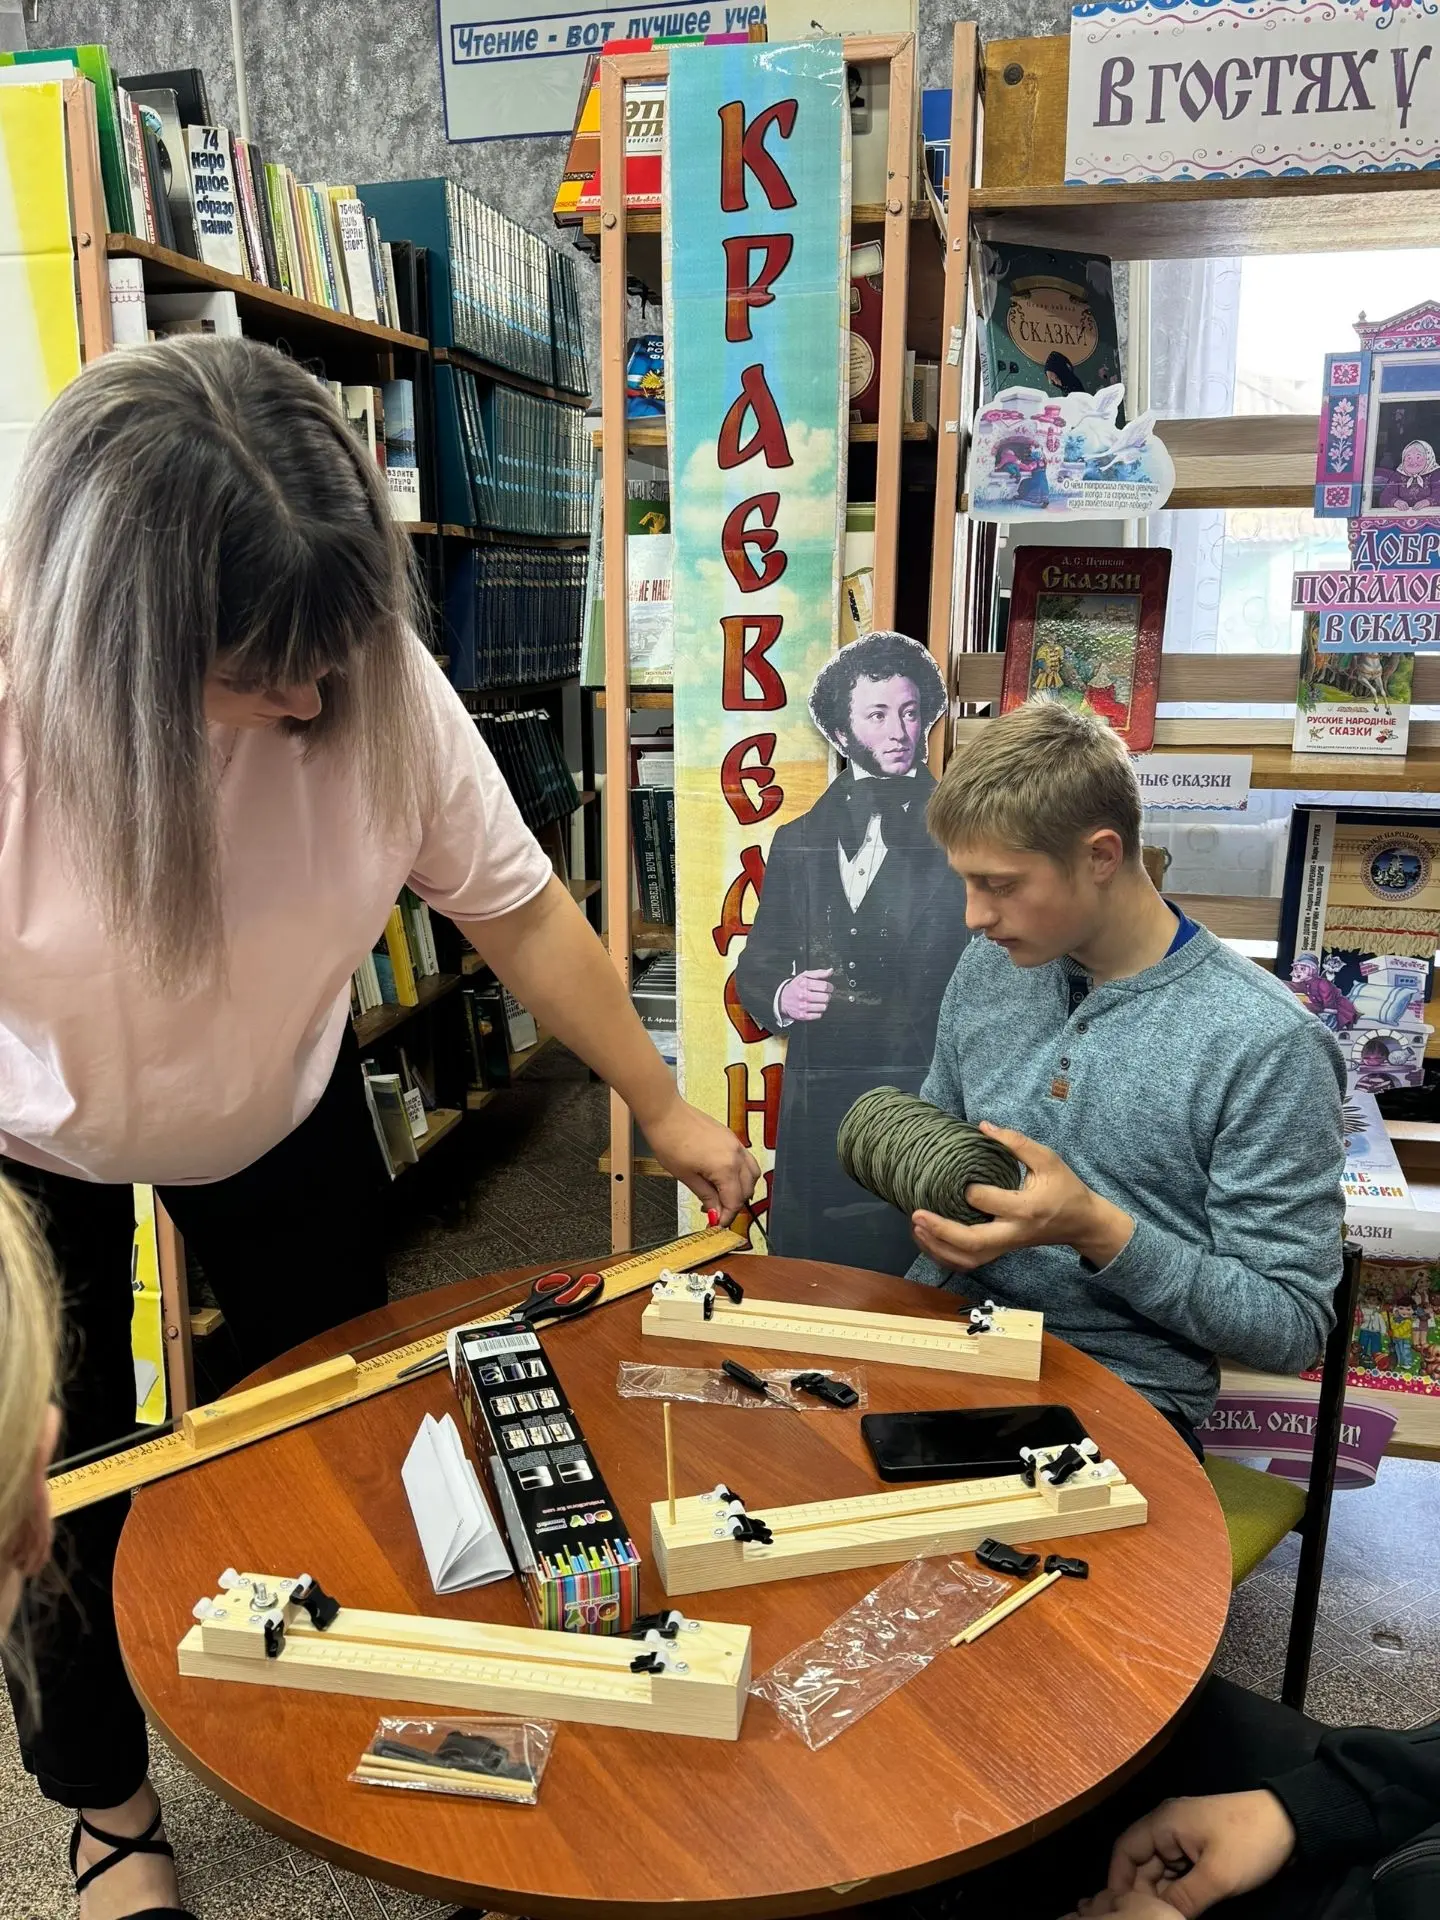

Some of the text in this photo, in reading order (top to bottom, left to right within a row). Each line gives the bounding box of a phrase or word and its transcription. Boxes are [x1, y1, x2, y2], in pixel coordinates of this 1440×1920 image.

[458, 28, 539, 58] Чтение
[565, 21, 616, 48] вот
[627, 10, 712, 39] лучшее
[1093, 45, 1433, 129] В ГОСТЯХ У
[202, 128, 219, 150] 74
[191, 151, 225, 174] наро
[195, 175, 229, 194] дное
[197, 194, 234, 219] образо
[201, 220, 233, 234] вание
[1020, 320, 1088, 347] СКАЗКИ
[1042, 565, 1141, 590] Сказки
[1322, 614, 1344, 643] В
[1306, 716, 1397, 726] РУССКИЕ НАРОДНЫЕ
[1329, 727, 1373, 736] СКАЗКИ
[1172, 773, 1232, 788] СКАЗКИ
[644, 851, 656, 872] НОЧИ
[648, 881, 661, 919] ИСПОВЕДЬ
